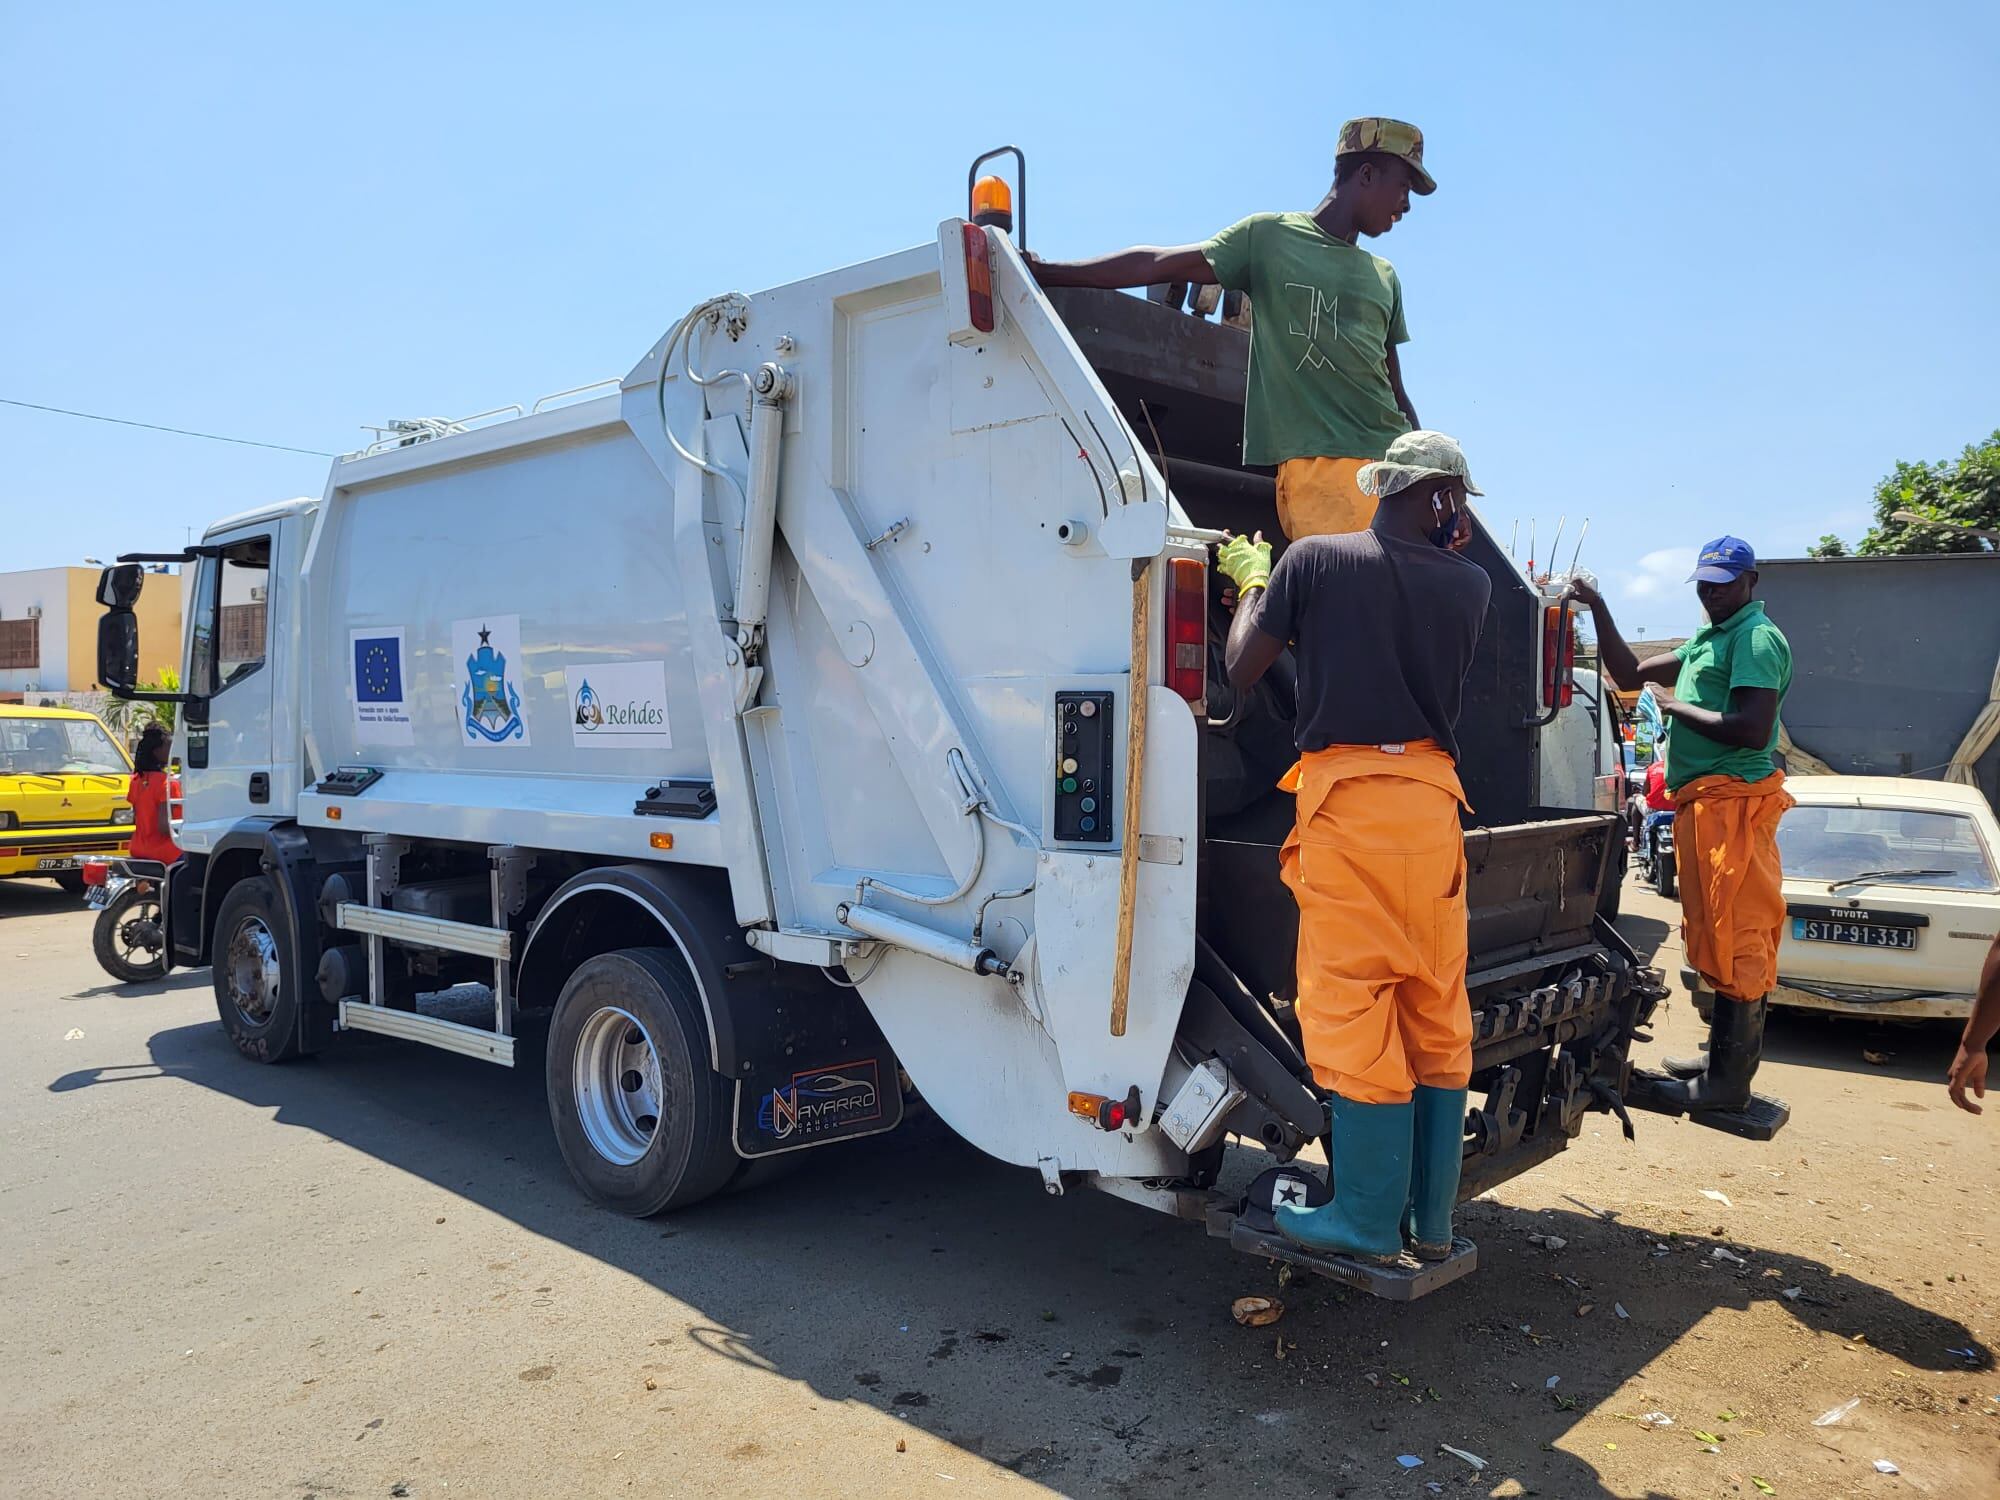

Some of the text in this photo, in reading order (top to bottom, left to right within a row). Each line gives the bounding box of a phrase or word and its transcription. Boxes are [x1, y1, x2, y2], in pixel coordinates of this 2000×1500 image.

[606, 700, 663, 725] Rehdes
[1829, 908, 1869, 920] TOYOTA
[773, 1087, 876, 1130] NAVARRO
[798, 1122, 839, 1135] TRUCK
